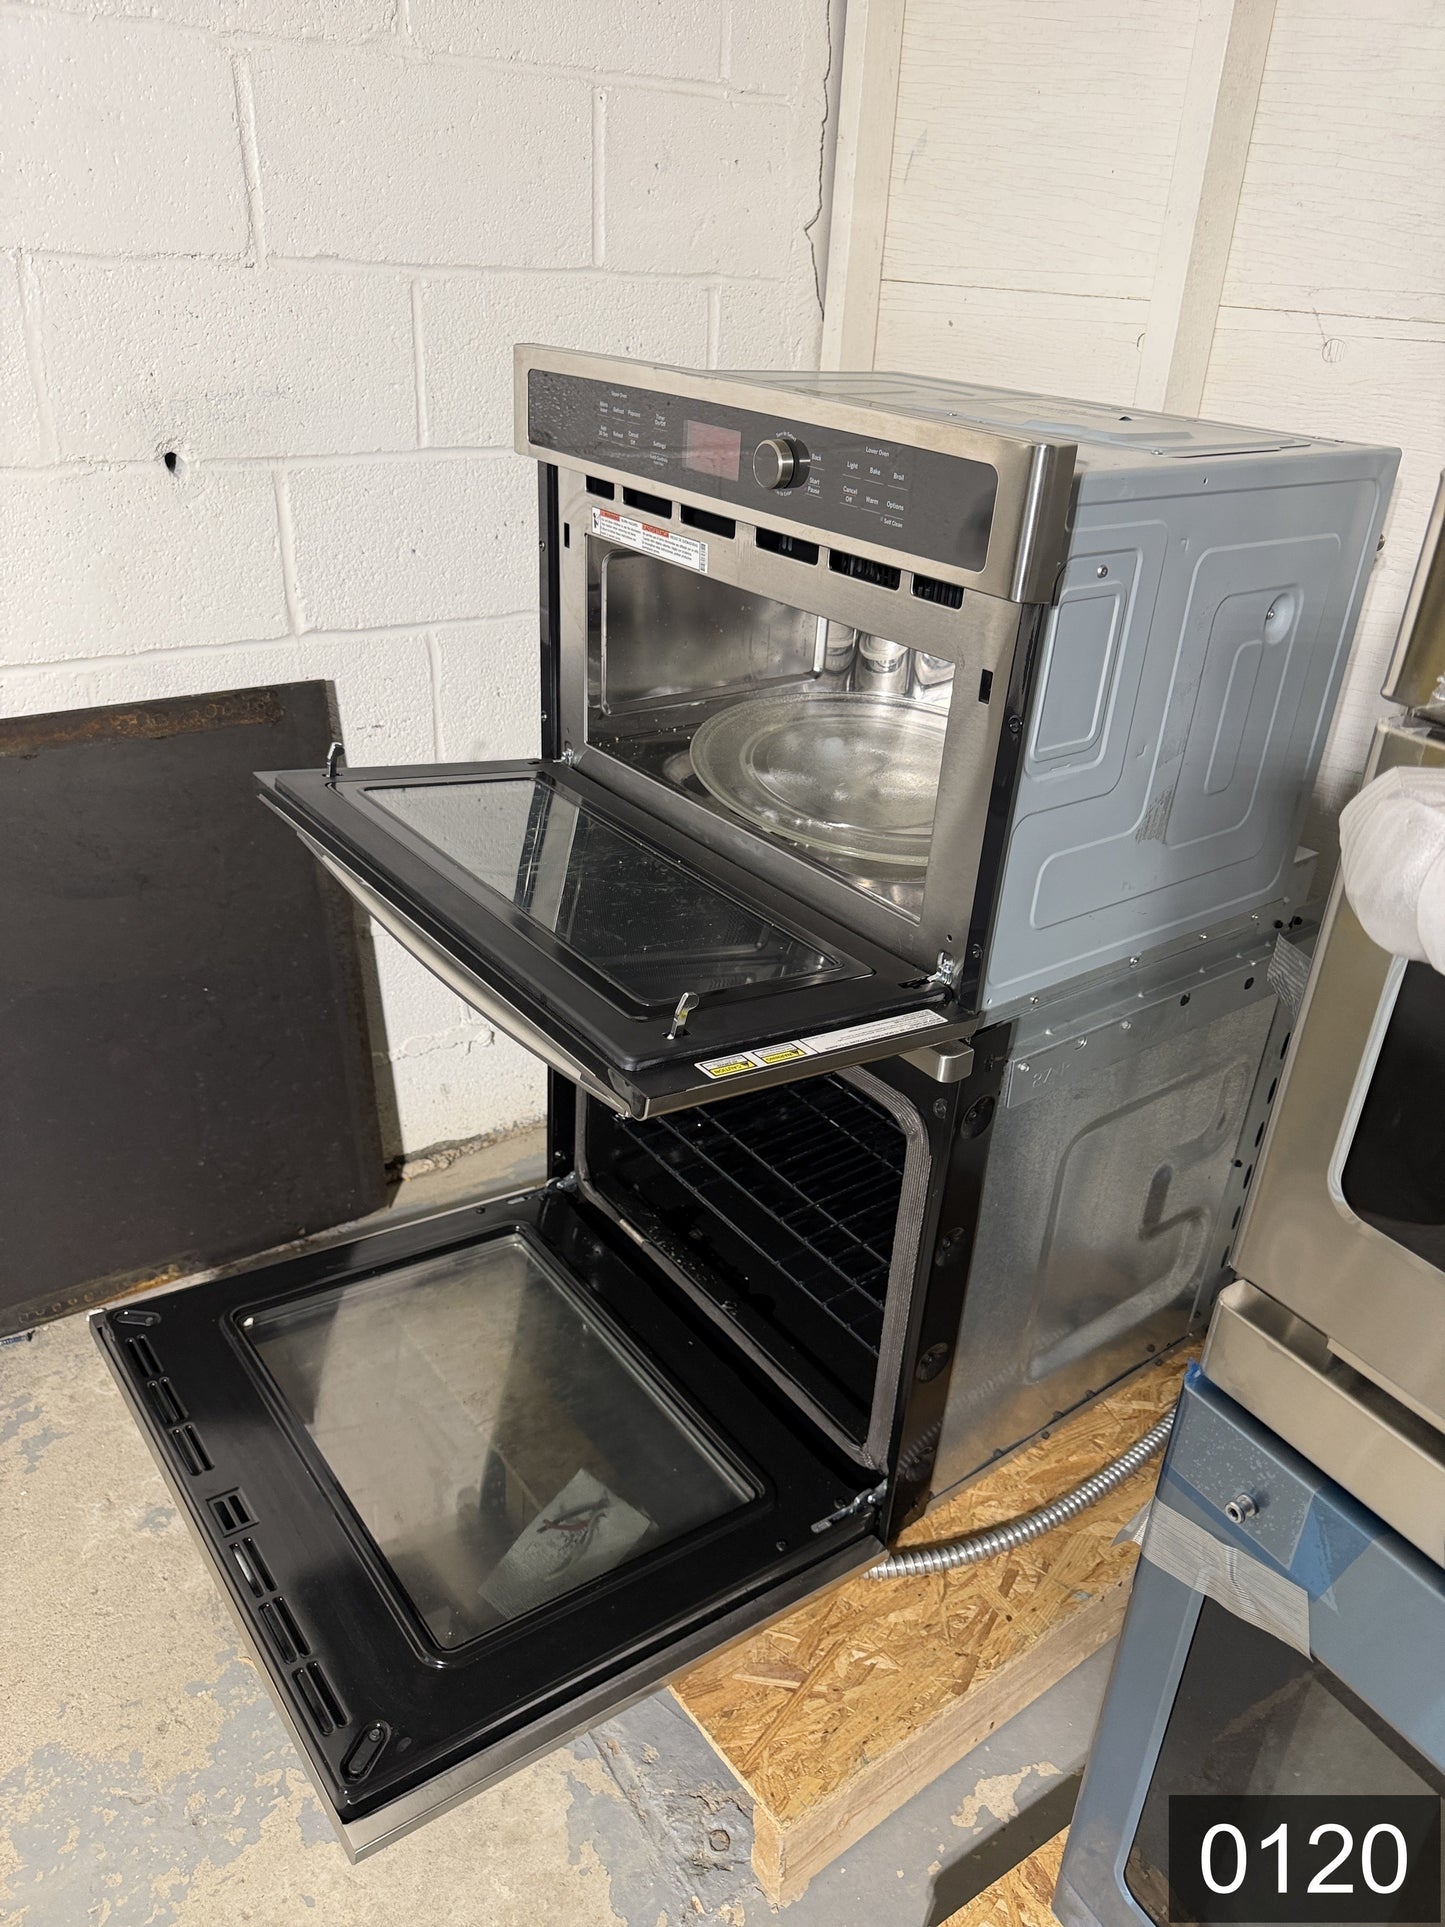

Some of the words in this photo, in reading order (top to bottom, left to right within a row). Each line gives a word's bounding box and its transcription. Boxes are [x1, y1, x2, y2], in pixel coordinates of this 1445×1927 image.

[866, 446, 878, 455] Lower
[879, 449, 890, 457] Oven
[812, 453, 822, 461] Back
[847, 461, 858, 470] Light
[870, 467, 881, 476] Bake
[809, 477, 820, 485] Start
[893, 472, 905, 481] Broil
[808, 486, 820, 494] Pause
[843, 485, 858, 495] Cancel
[845, 495, 853, 503] Off
[866, 496, 879, 505] Warm
[886, 500, 904, 511] Options
[714, 1064, 743, 1075] CAUTION
